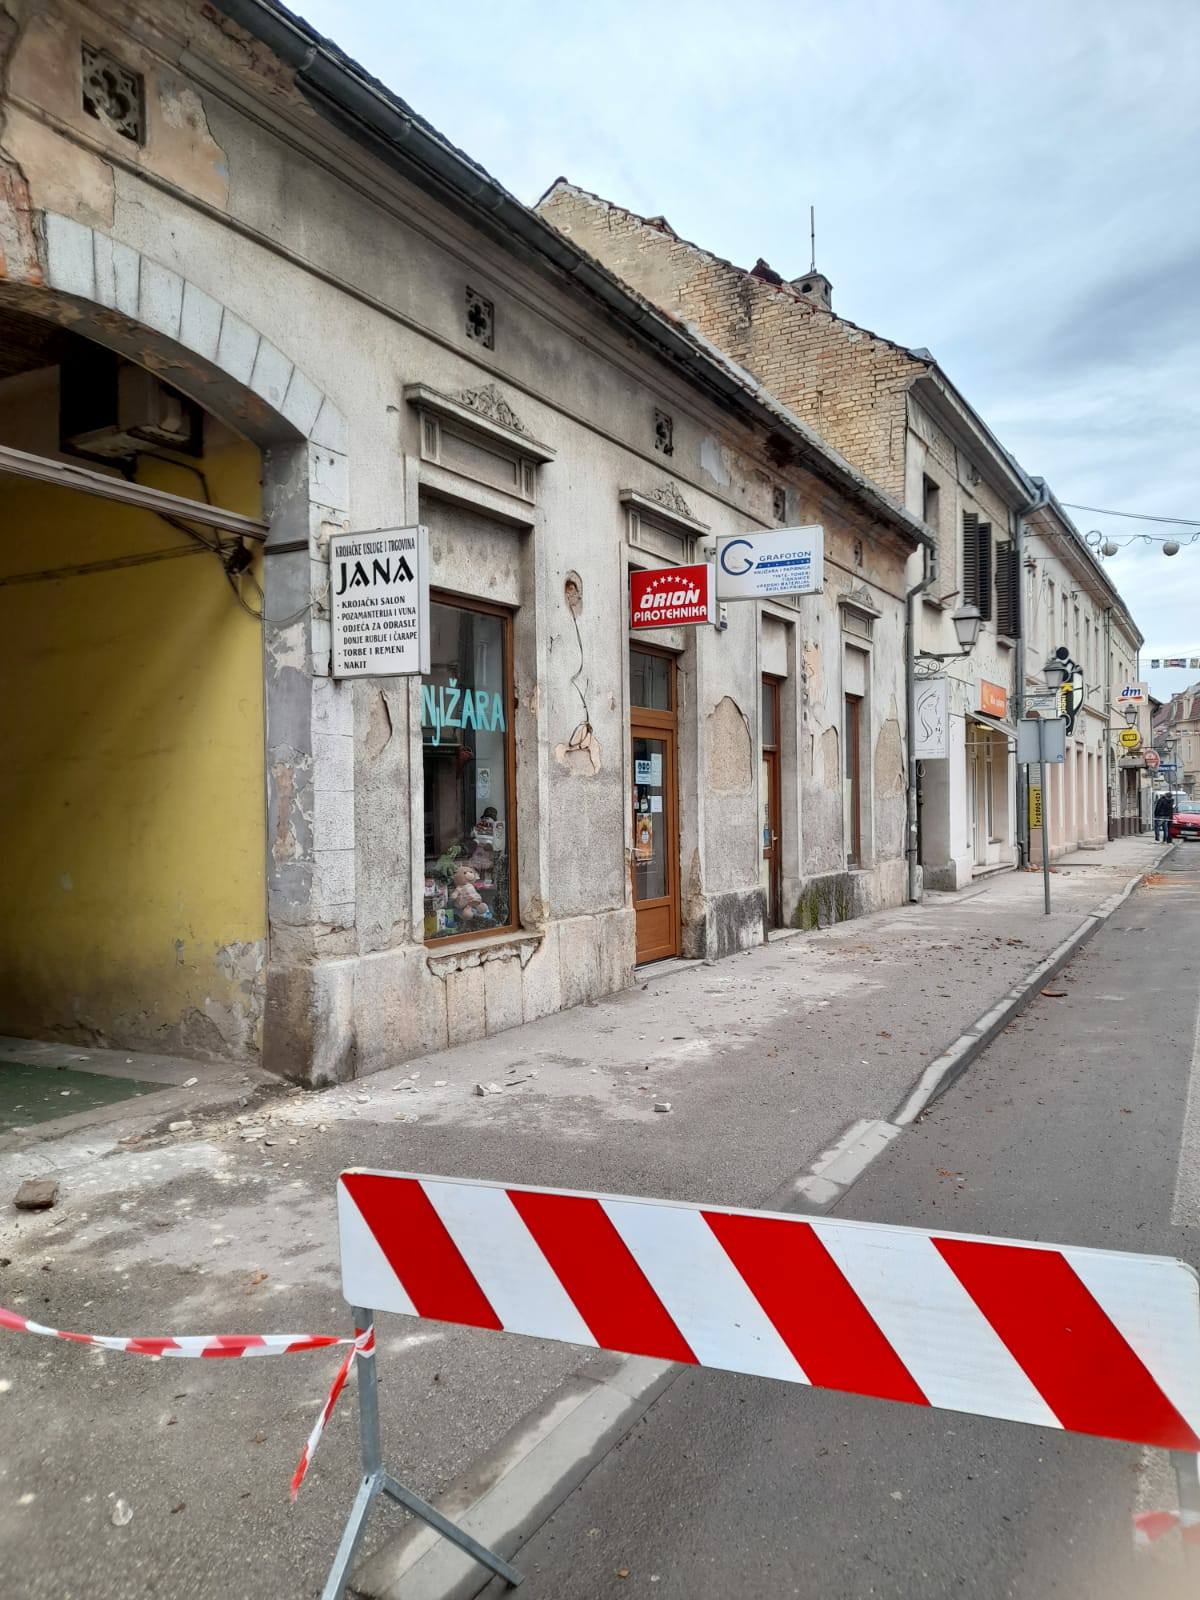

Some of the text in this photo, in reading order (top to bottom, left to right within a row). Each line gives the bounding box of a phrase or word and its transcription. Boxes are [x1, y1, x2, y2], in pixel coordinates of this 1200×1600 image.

[335, 541, 361, 557] KROJAČKE
[363, 541, 383, 555] USLUGE
[388, 537, 415, 552] TRGOVINA
[759, 551, 811, 561] GRAFOTON
[335, 555, 414, 596] JANA
[341, 595, 405, 609] KROJAČKI SALON
[640, 588, 701, 609] ORION
[341, 609, 392, 621] POZAMANTERIJA
[399, 606, 416, 616] VUNA
[634, 605, 707, 623] PIROTEHNIKA
[372, 622, 381, 631] ZA
[383, 619, 416, 630] ODRASLE
[343, 635, 364, 645] DONJE
[365, 633, 387, 643] RUBLJE
[393, 630, 417, 641] ČARAPE
[343, 648, 367, 657] TORBE
[375, 645, 404, 655] REMENI
[343, 660, 367, 669] NAKIT
[1121, 686, 1141, 697] dm
[420, 677, 506, 746] NJIŽARA
